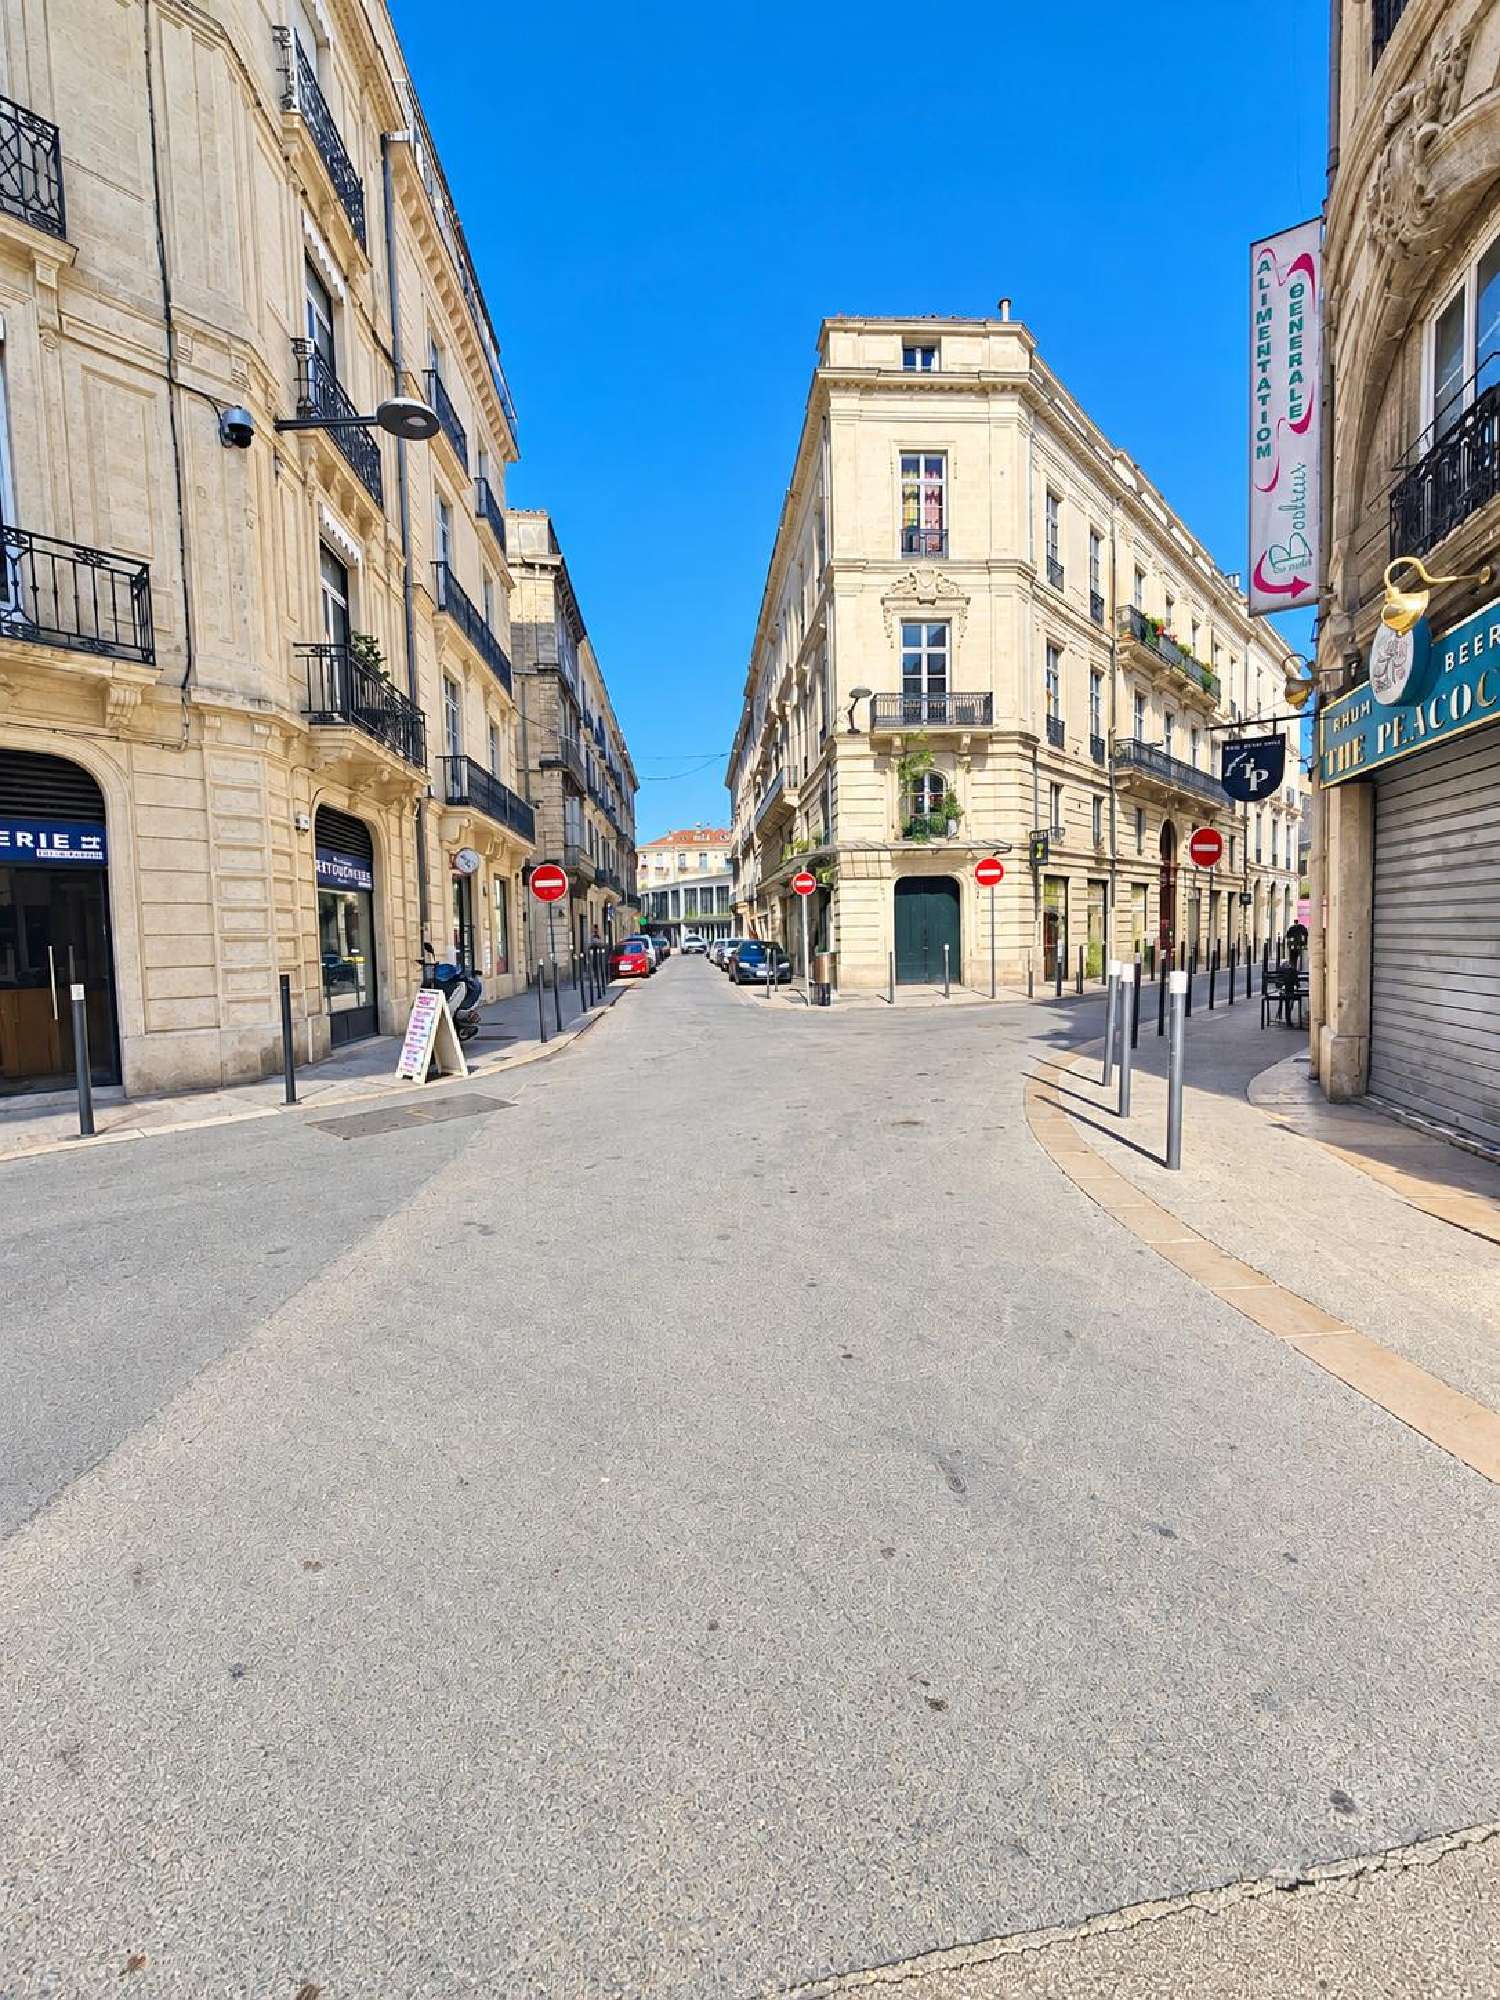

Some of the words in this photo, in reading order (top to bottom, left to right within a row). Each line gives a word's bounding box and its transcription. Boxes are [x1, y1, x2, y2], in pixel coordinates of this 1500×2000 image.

[1333, 700, 1372, 733] RHUM
[1445, 623, 1500, 673] BEER
[1325, 735, 1367, 776] THE
[0, 830, 70, 849] ERIE
